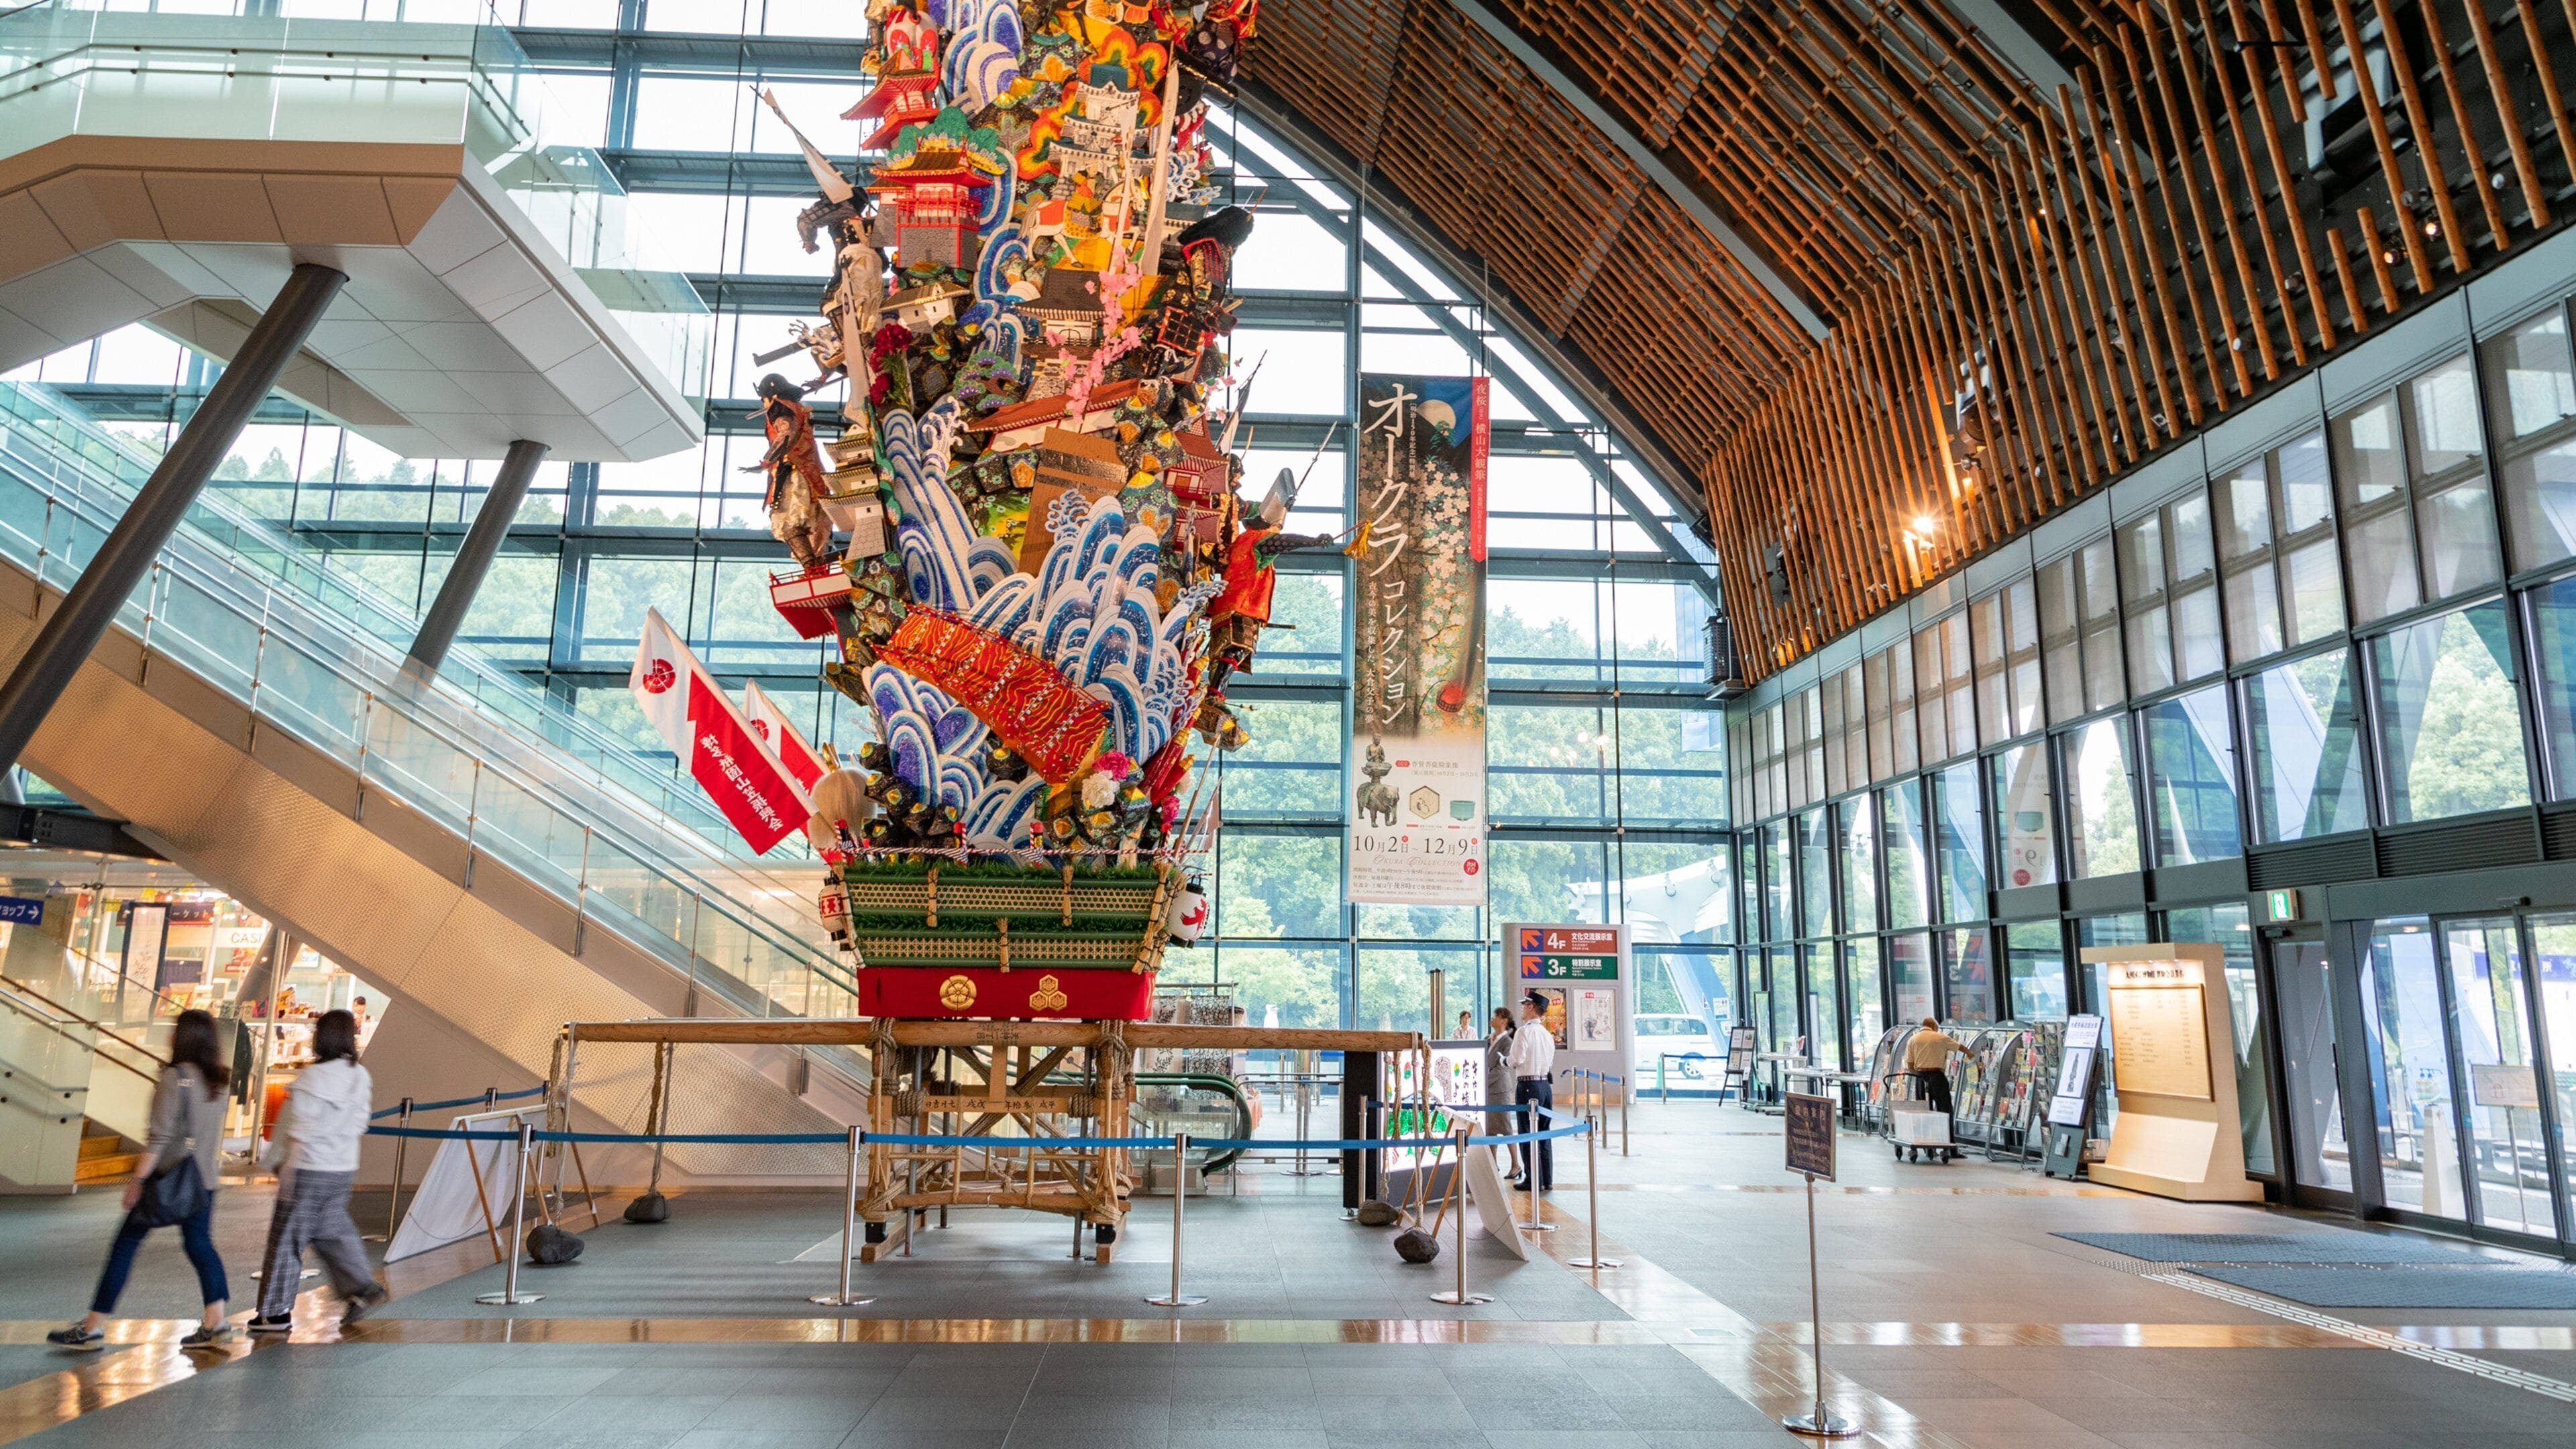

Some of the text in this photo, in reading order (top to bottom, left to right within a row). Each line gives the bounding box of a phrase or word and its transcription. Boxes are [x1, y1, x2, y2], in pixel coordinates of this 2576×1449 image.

[1476, 384, 1487, 407] 夜桜
[1474, 423, 1487, 480] 横山大観筆
[0, 904, 26, 918] ョップ
[1547, 932, 1566, 949] 4F
[1548, 959, 1567, 975] 3F
